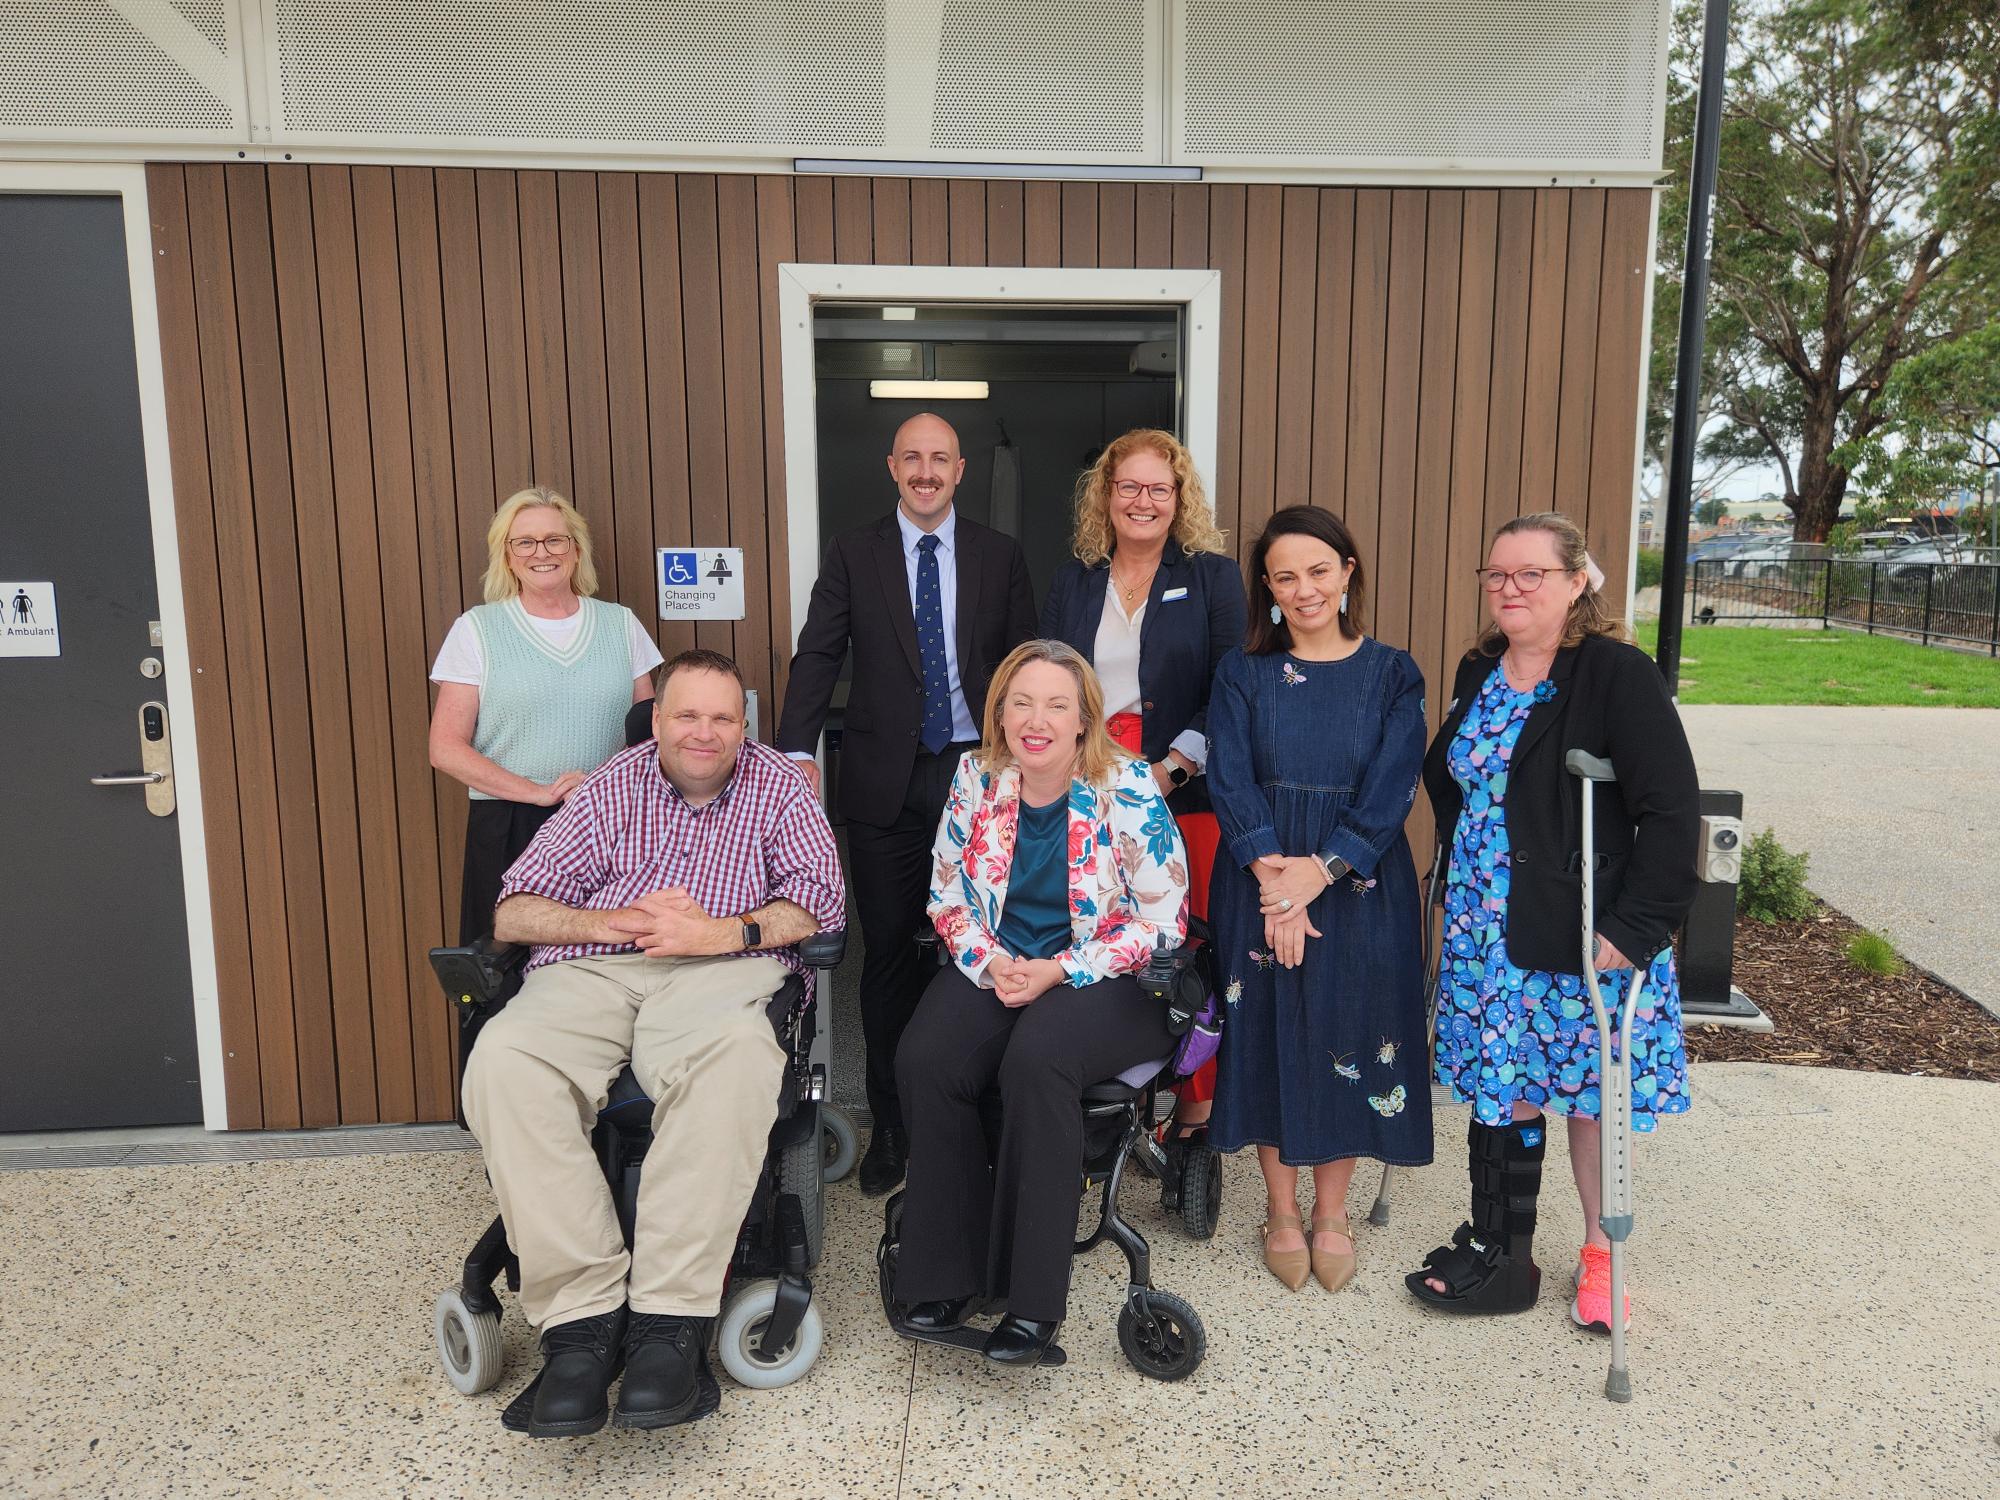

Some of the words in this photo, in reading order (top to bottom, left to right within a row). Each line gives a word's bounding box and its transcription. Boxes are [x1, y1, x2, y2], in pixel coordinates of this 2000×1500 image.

[665, 590, 716, 601] Changing
[665, 600, 701, 610] Places
[7, 627, 55, 636] Ambulant
